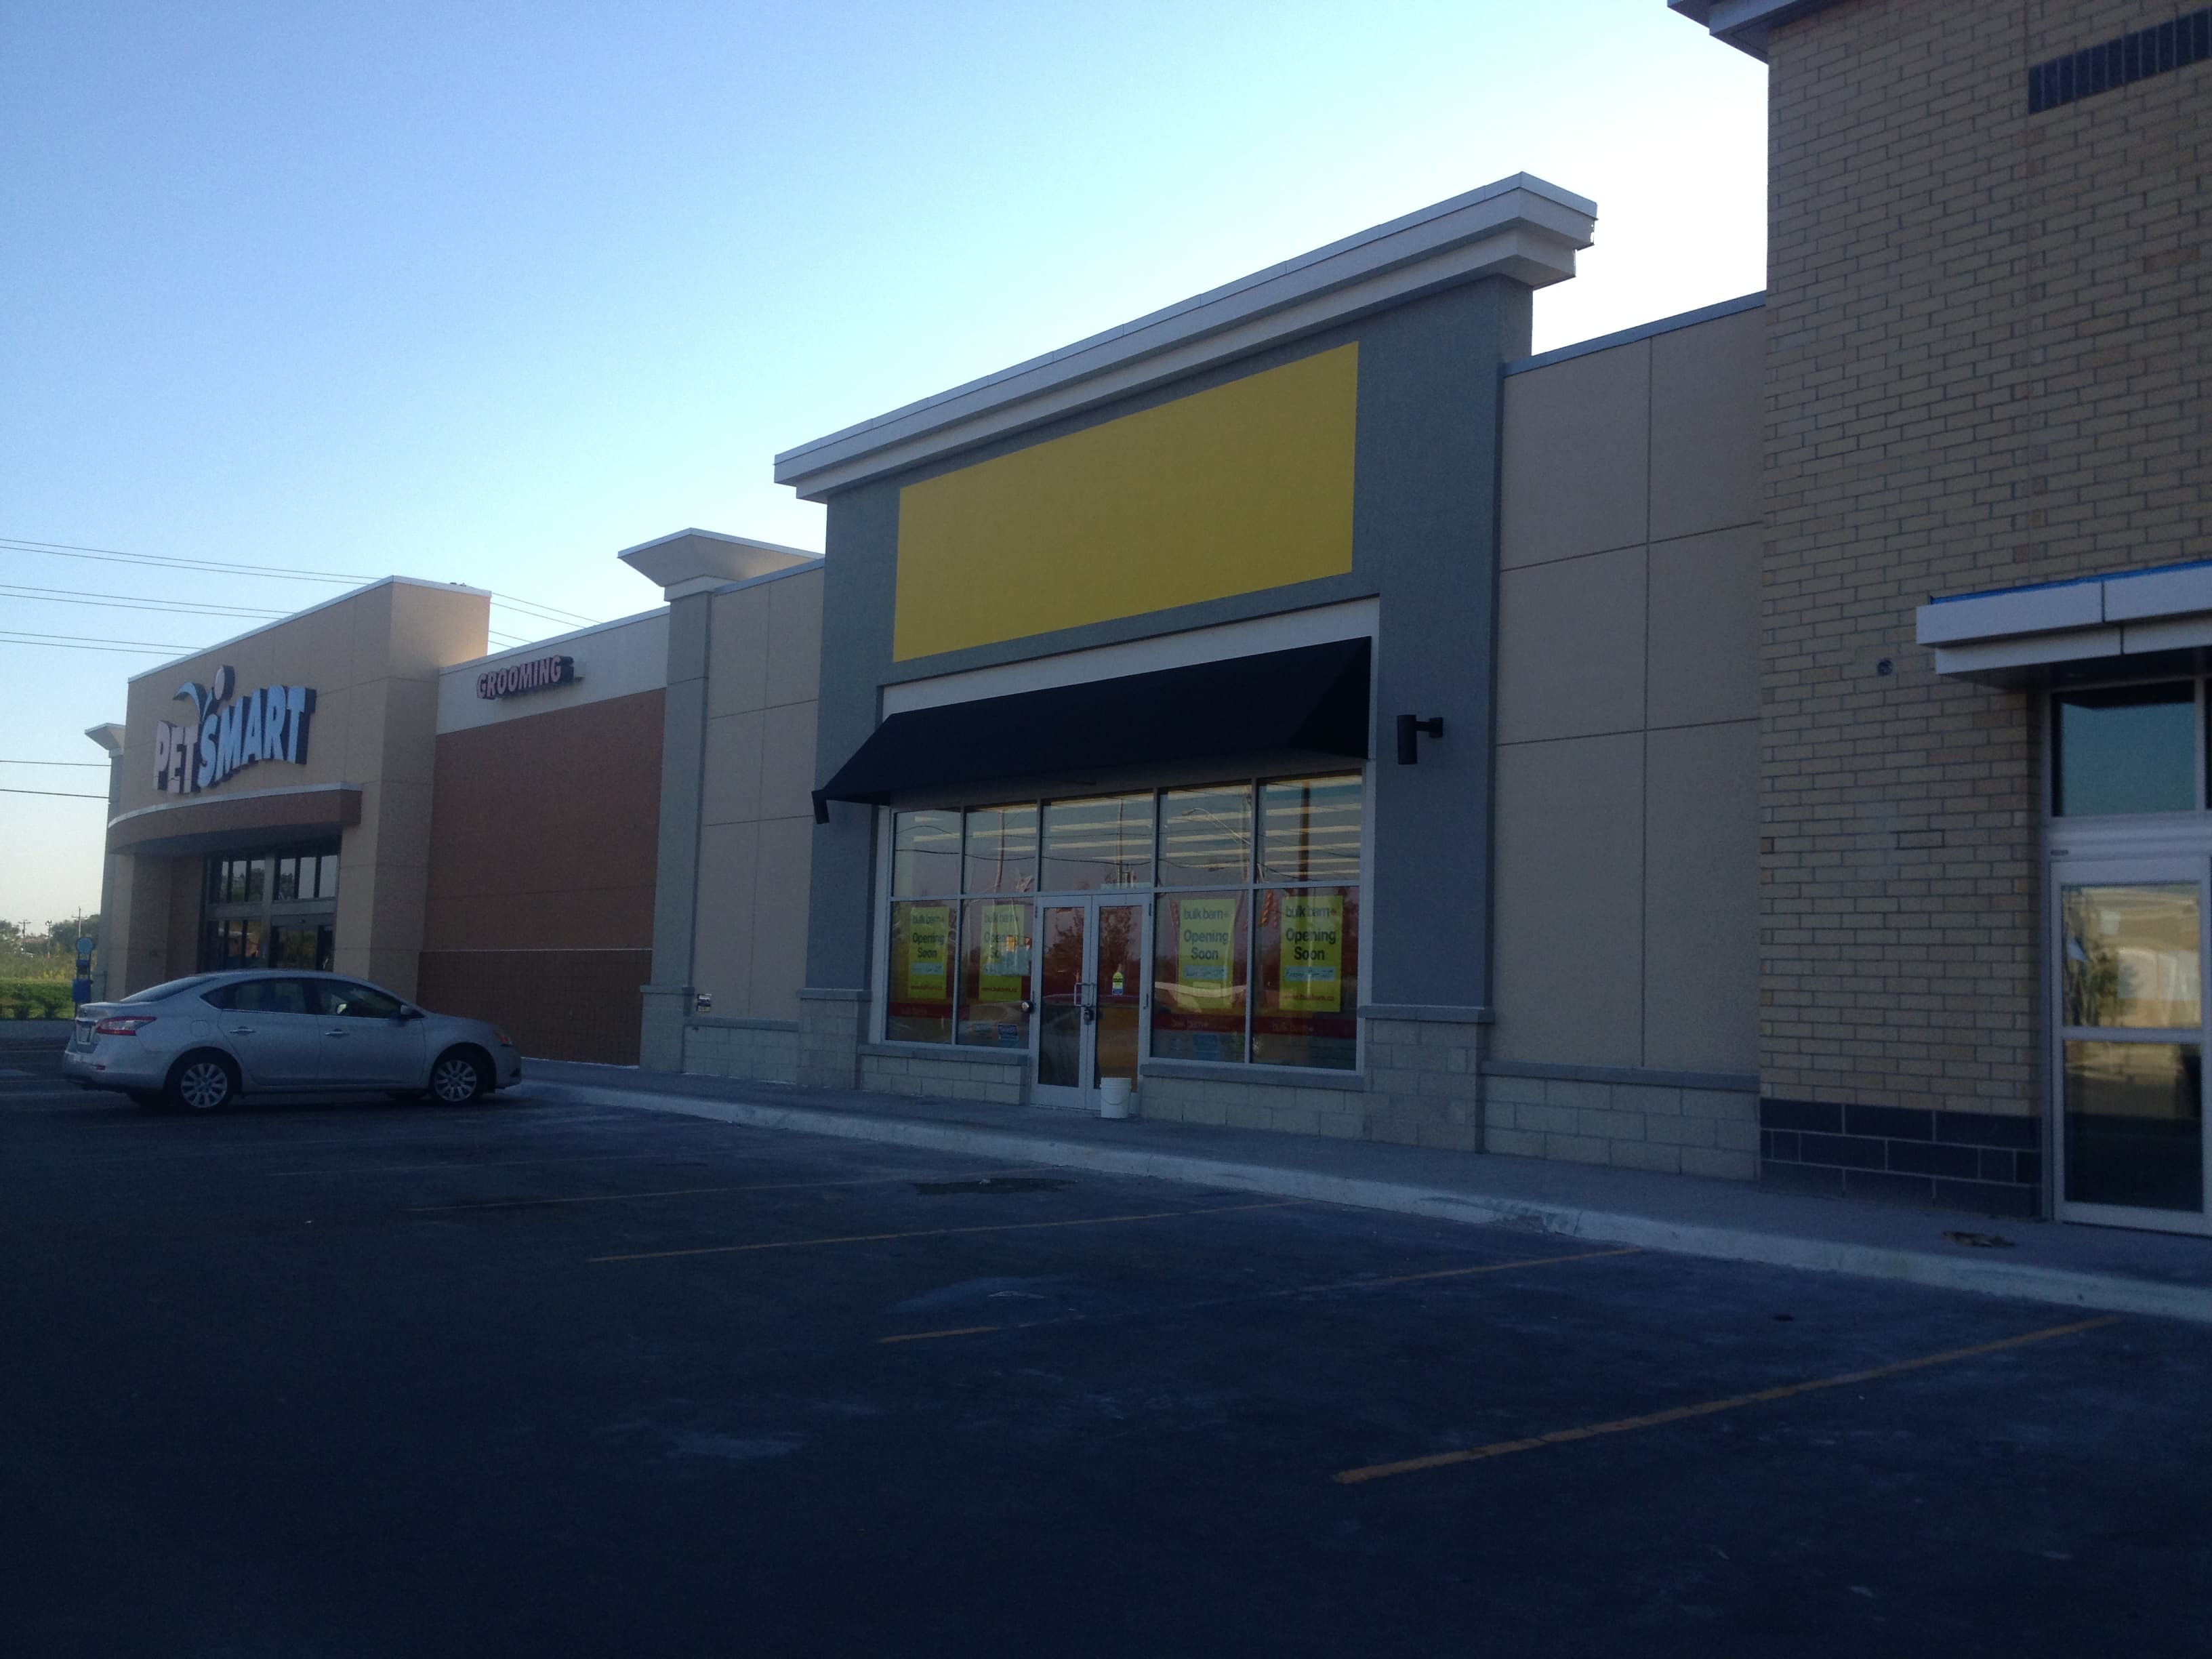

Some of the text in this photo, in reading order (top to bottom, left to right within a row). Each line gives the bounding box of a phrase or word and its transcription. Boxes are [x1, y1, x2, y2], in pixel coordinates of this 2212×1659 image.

[476, 655, 562, 699] GROOMING
[1203, 908, 1223, 919] barn
[912, 932, 945, 945] Opening
[1184, 929, 1228, 945] Opening
[1286, 928, 1336, 945] Opening
[918, 947, 937, 958] Soon
[1191, 946, 1218, 960] Soon
[1294, 946, 1325, 960] Soon
